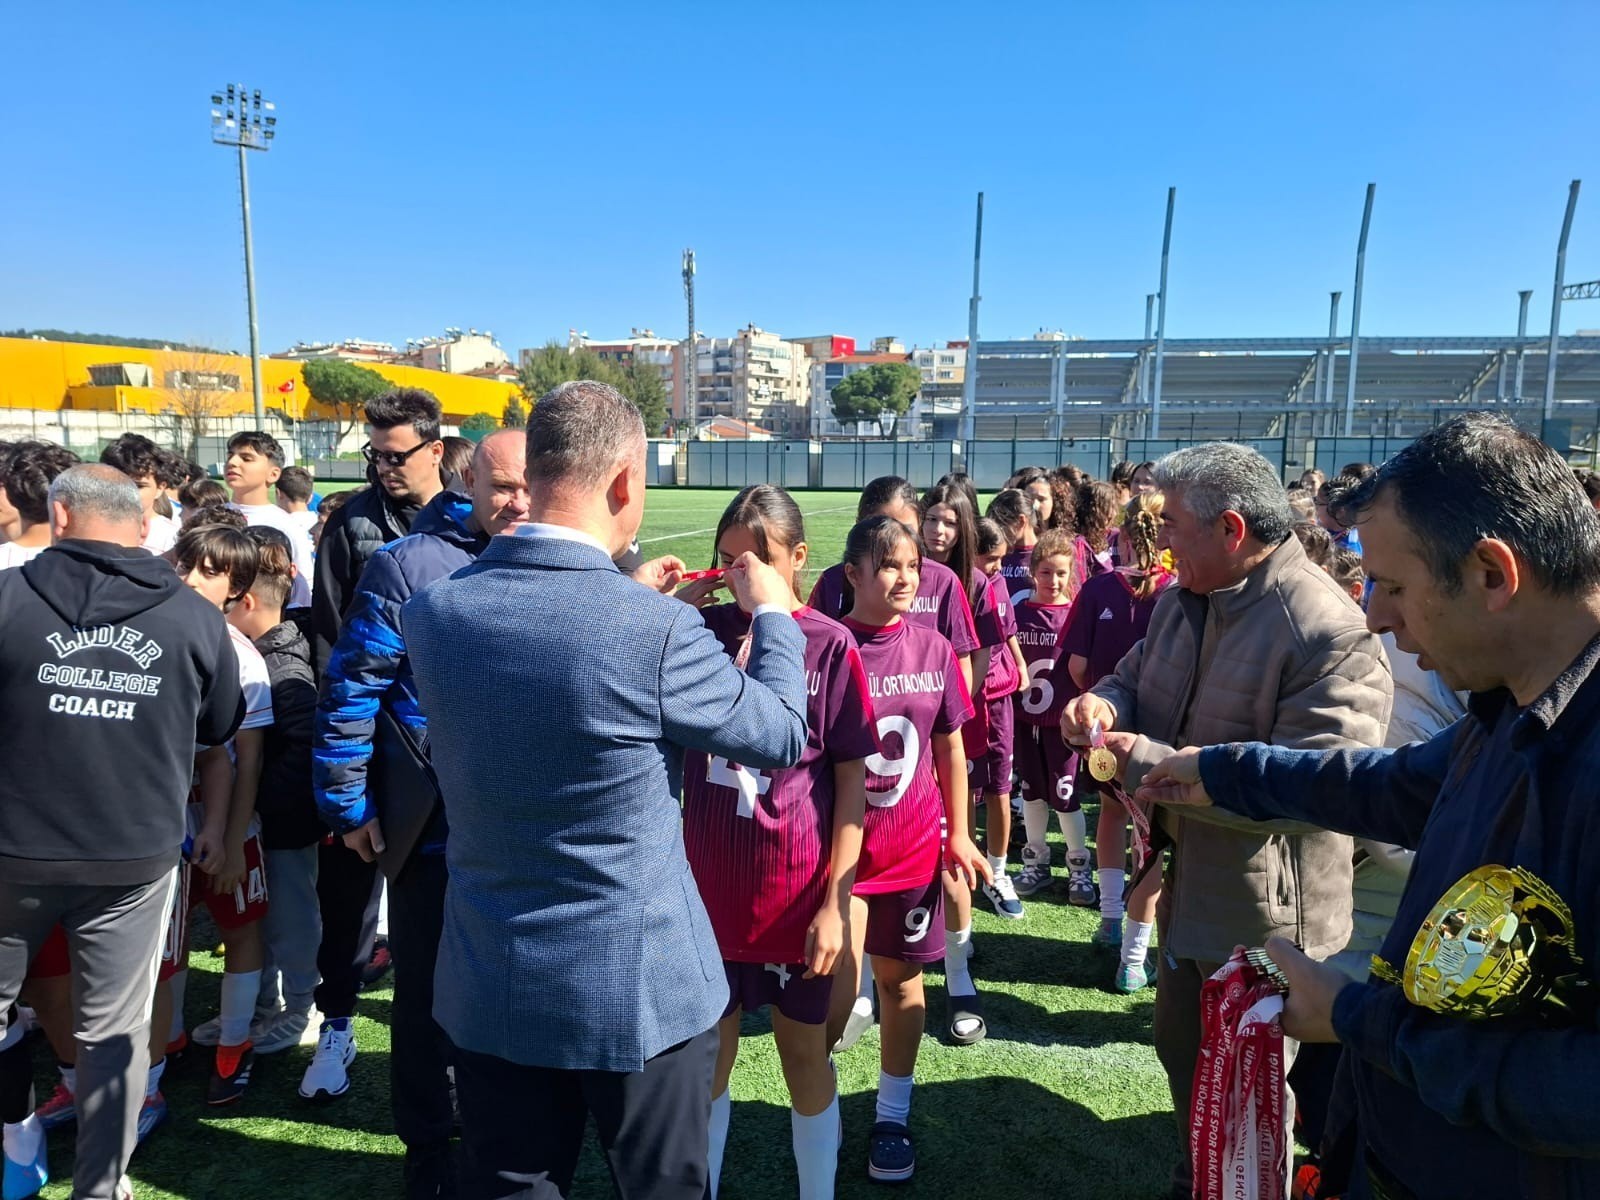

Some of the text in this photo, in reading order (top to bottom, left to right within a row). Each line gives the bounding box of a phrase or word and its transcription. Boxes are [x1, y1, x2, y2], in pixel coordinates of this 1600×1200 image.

[38, 663, 162, 696] COLLEGE
[883, 670, 945, 697] ORTAOKULU
[1021, 658, 1055, 715] 6
[49, 693, 137, 720] COACH
[865, 715, 920, 808] 9
[706, 754, 772, 819] 4
[1056, 775, 1074, 800] 6
[904, 906, 931, 943] 9
[1210, 1056, 1225, 1104] GENÇLİK
[1195, 1084, 1209, 1113] SPOR
[1210, 1104, 1220, 1117] VE
[1208, 1118, 1219, 1148] SPOR
